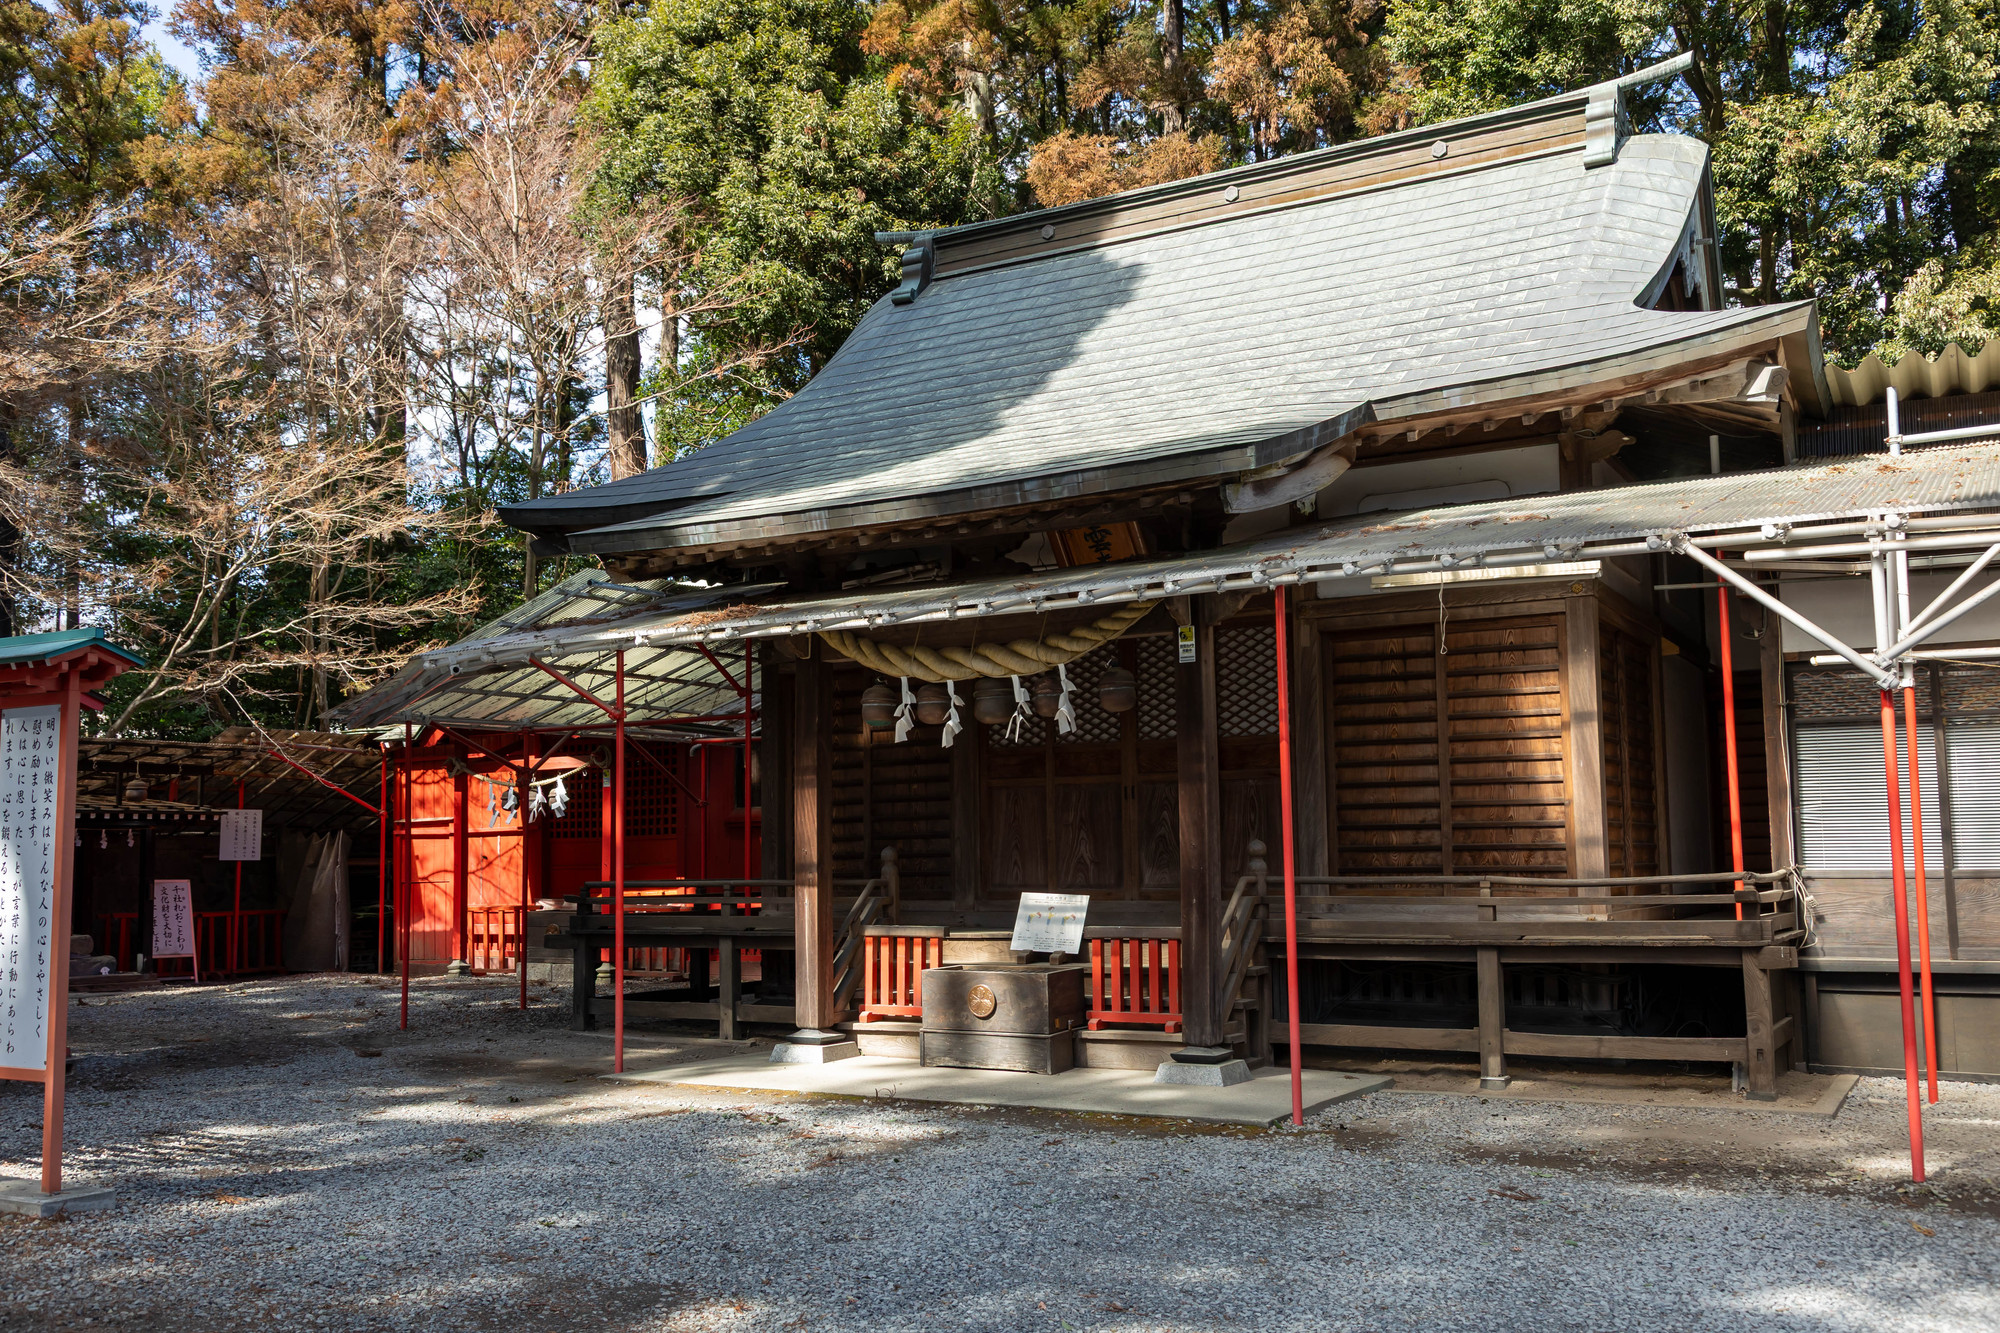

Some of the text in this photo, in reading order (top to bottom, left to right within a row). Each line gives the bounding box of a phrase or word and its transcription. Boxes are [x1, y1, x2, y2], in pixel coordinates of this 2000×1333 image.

[28, 719, 42, 847] 慰め励まします。
[6, 720, 28, 1054] 人は心に思ったことが言葉に行動にあらわ
[34, 717, 56, 1038] 明るい微笑みはどんな人の心もやさしく
[161, 886, 172, 947] 文化財を大切に
[172, 885, 185, 951] 千社札おことわり
